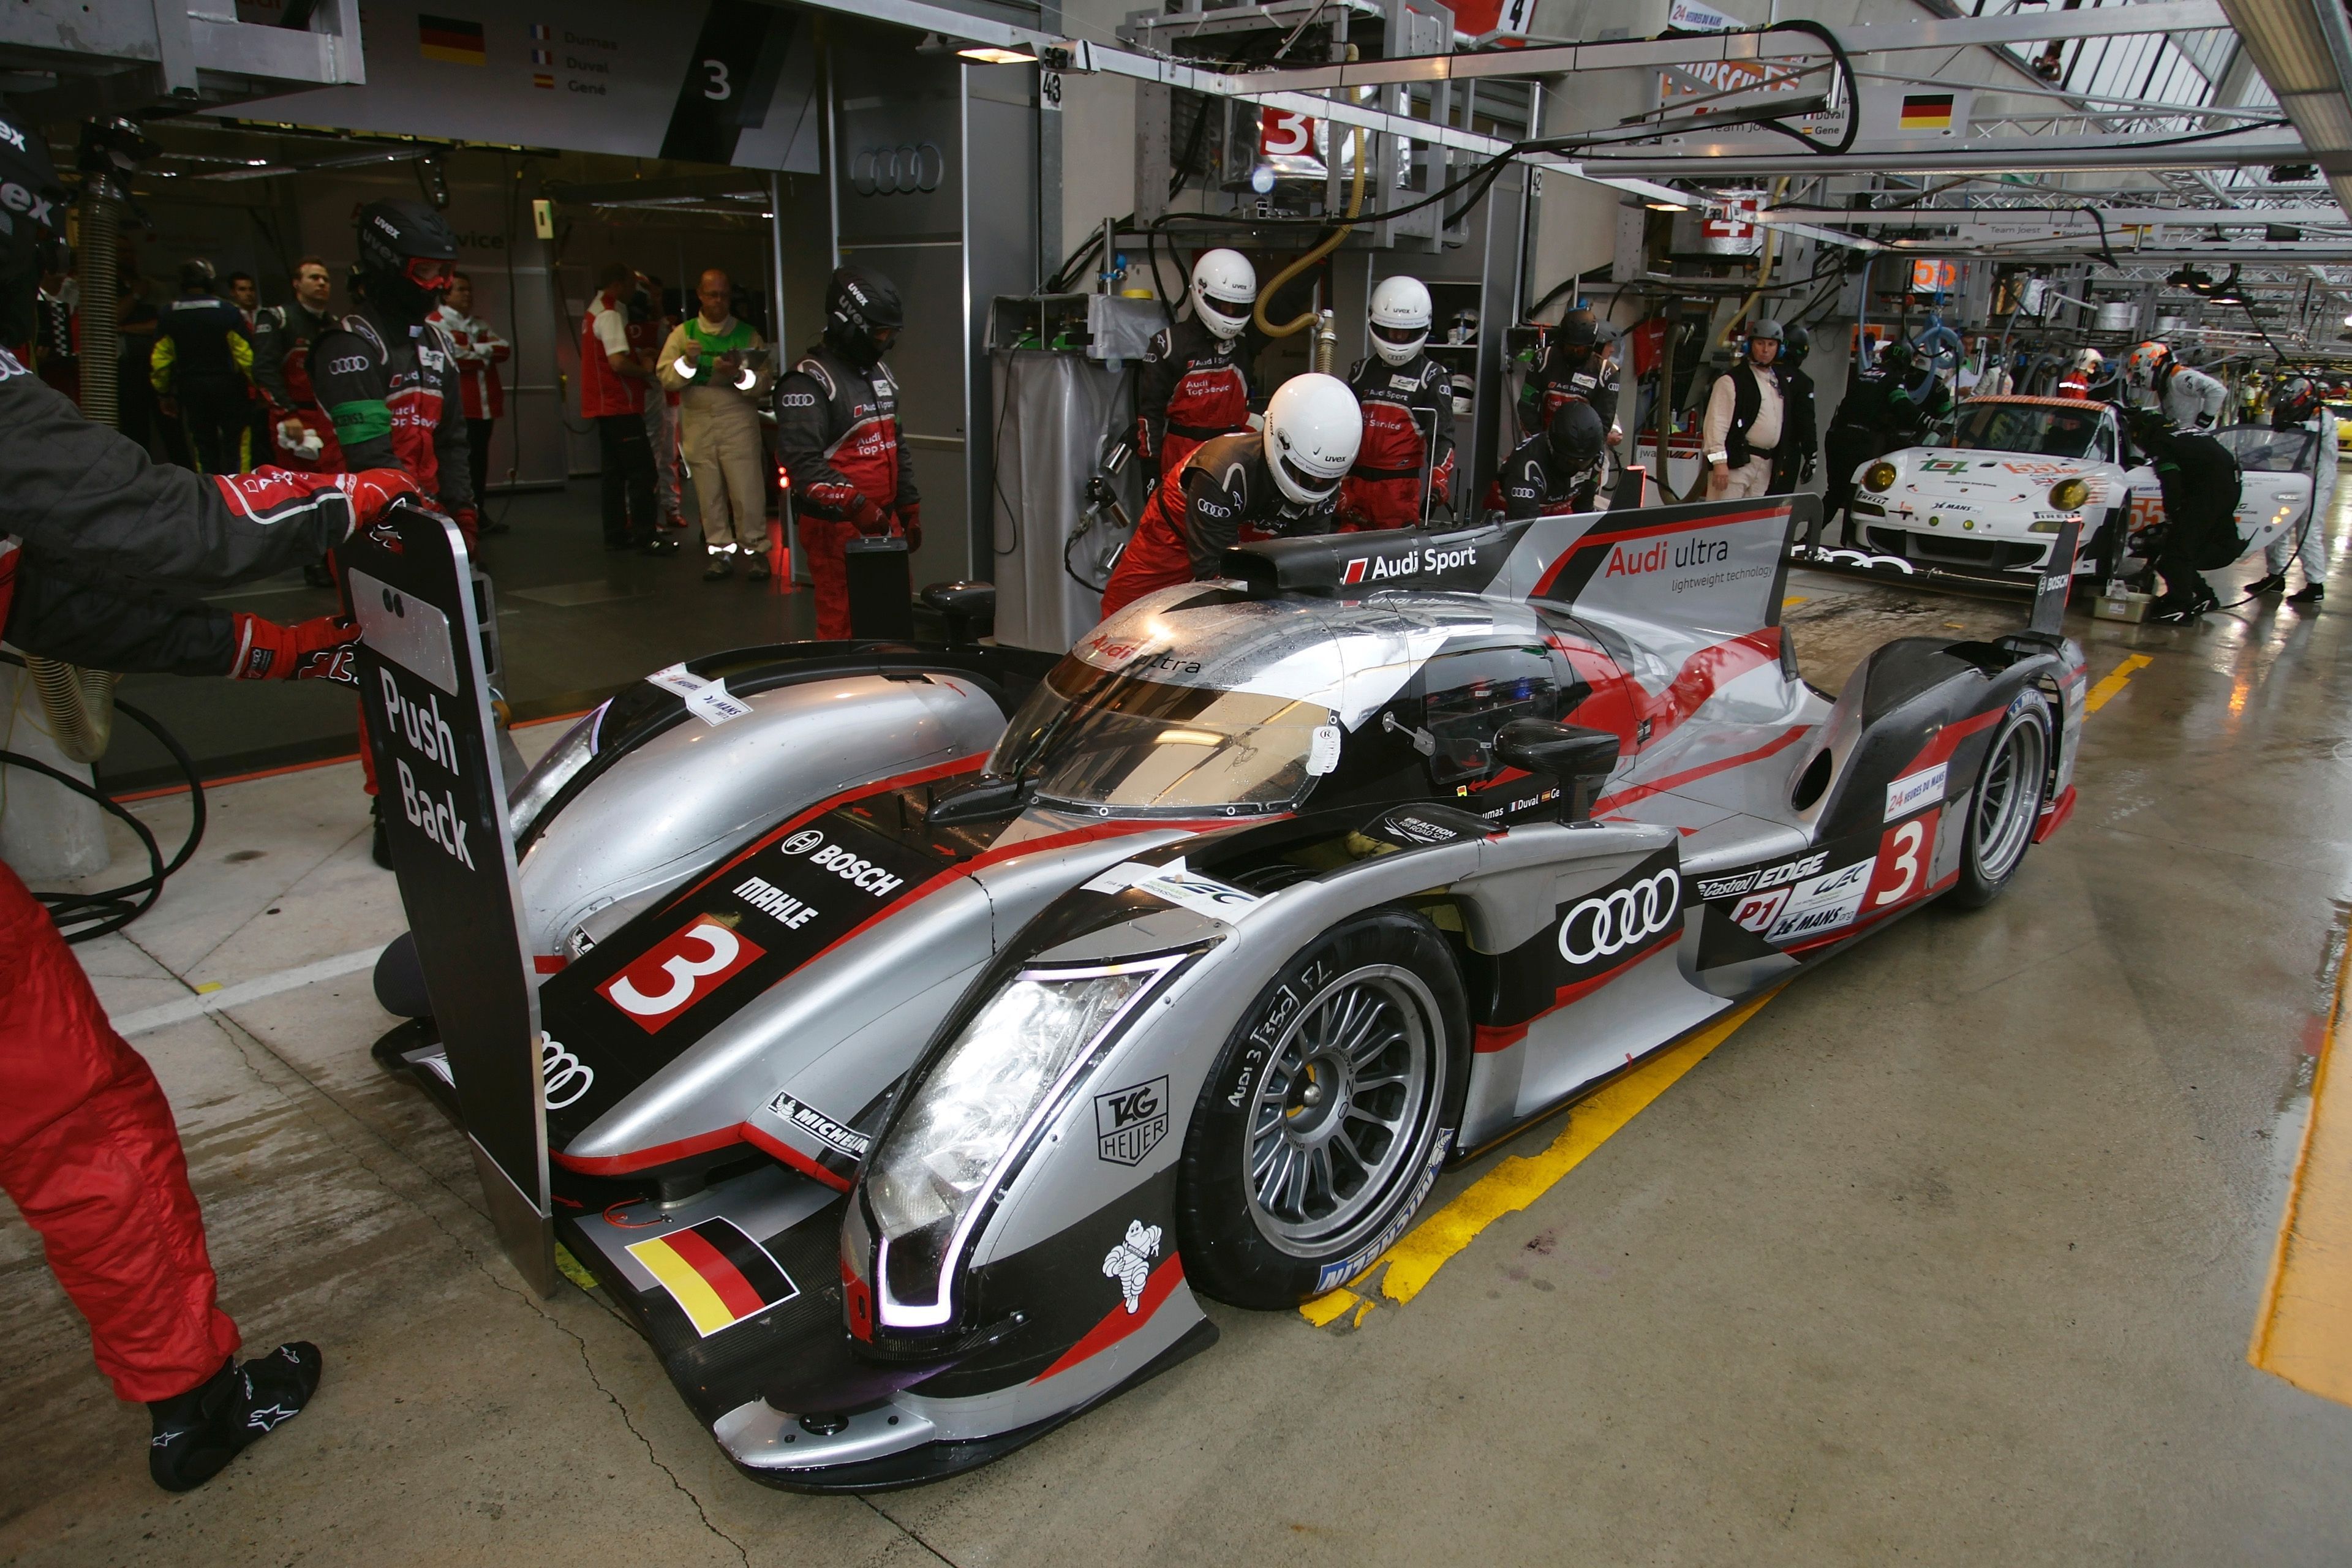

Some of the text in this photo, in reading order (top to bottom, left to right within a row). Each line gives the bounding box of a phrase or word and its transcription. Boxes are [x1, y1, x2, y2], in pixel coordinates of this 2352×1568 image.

[564, 31, 617, 50] Dumas
[566, 57, 609, 74] Duval
[703, 59, 731, 100] 3
[1043, 72, 1061, 103] 43
[1265, 113, 1308, 154] 3
[1532, 172, 1542, 189] 42
[374, 216, 401, 239] uvex
[848, 282, 869, 307] uvex
[839, 295, 870, 334] uvex
[1186, 380, 1208, 388] Audi
[1186, 388, 1203, 397] Top
[1386, 390, 1409, 401] Sport
[857, 432, 881, 447] Audi
[858, 445, 878, 456] Top
[1305, 465, 1333, 476] Vorsprung
[1324, 454, 1348, 463] uvex
[1371, 546, 1476, 579] Audi Sport
[1605, 538, 1728, 578] Audi ultra
[1672, 565, 1774, 594] lightweight technology
[2046, 573, 2070, 592] BOSCH
[1090, 635, 1136, 660] Audi
[379, 666, 459, 777] Push
[716, 702, 742, 717] MANS
[1482, 788, 1560, 820] umas Duval Ge
[1888, 771, 1945, 814] 24 HEURES DU MANS
[396, 757, 475, 871] Back
[1409, 825, 1434, 836] ROAD
[1417, 822, 1458, 838] ACTION
[809, 844, 904, 897] BOSCH
[1703, 850, 1830, 897] Castrol EDGE
[1875, 821, 1924, 905] 3
[732, 876, 819, 930] MAHLE
[1735, 897, 1779, 927] P1
[1793, 907, 1842, 932] MANS
[609, 924, 740, 1016] 3
[1332, 1047, 1354, 1075] RACING
[1227, 1067, 1253, 1108] AUDI
[1246, 1049, 1262, 1064] 3
[1109, 1086, 1159, 1128] TAG
[794, 1108, 870, 1154] MICHELIN
[1105, 1119, 1164, 1160] HEUER
